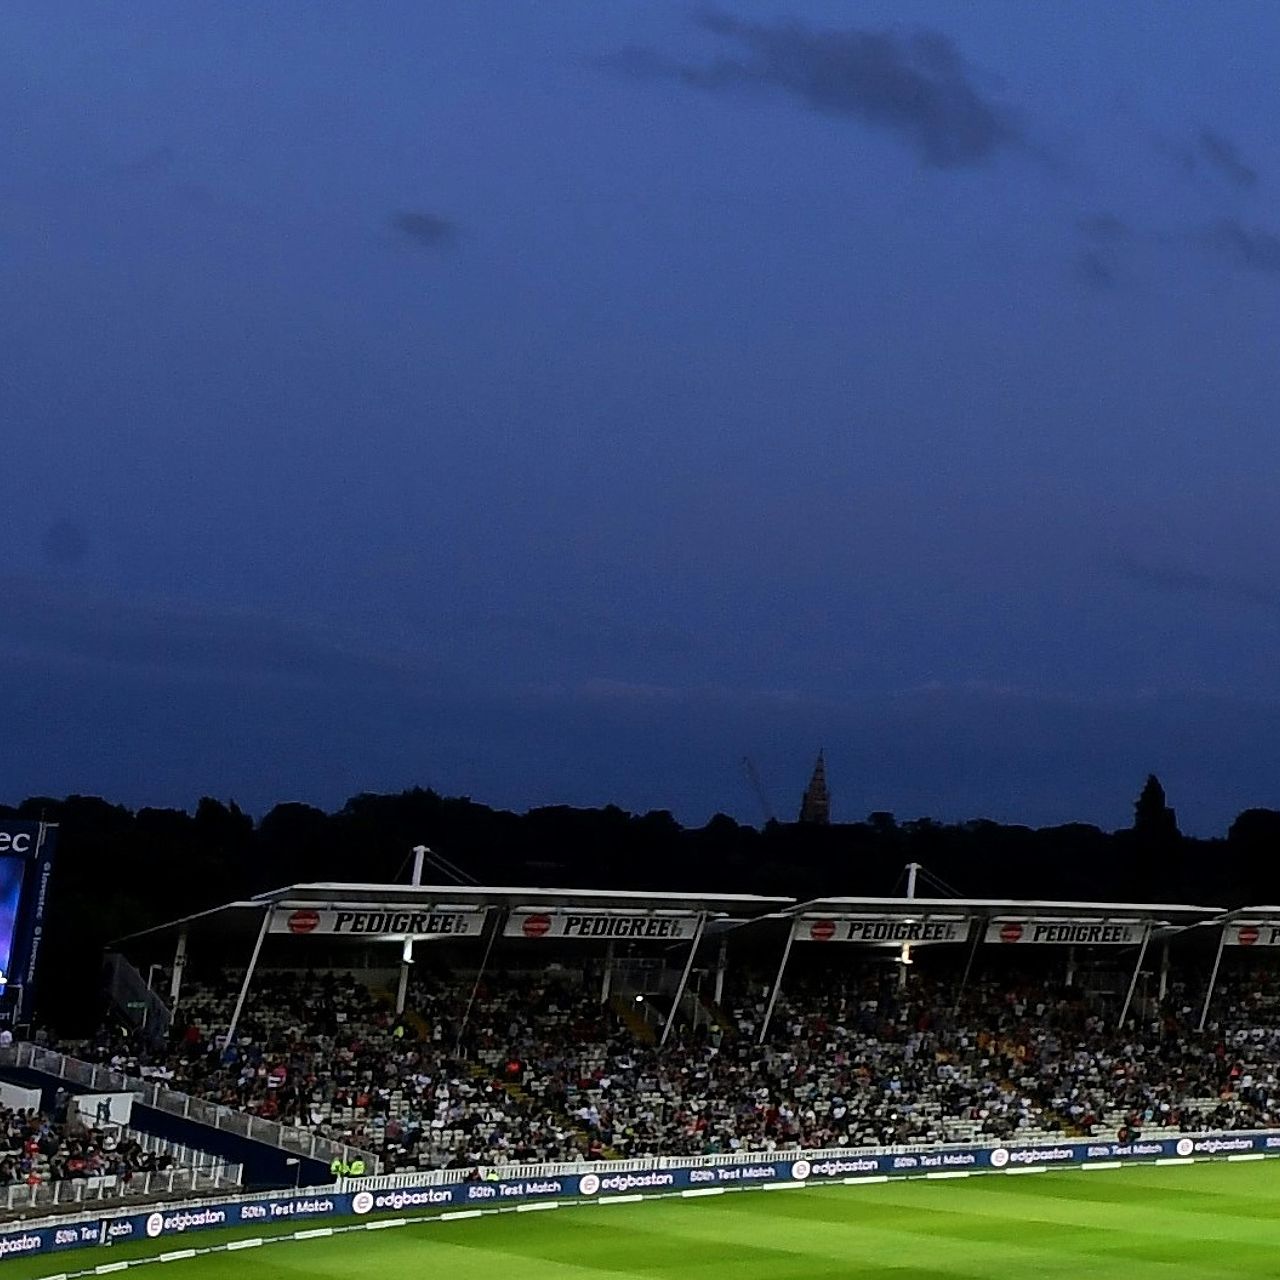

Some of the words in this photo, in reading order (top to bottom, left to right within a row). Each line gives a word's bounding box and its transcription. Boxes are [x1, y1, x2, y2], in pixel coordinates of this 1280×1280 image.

[333, 911, 456, 934] PEDIGREE
[562, 915, 672, 937] PEDIGREE
[846, 921, 946, 942] PEDIGREE
[1033, 923, 1124, 942] PEDIGREE
[1010, 1147, 1074, 1164] edgbaston
[690, 1169, 715, 1183] 50th
[717, 1167, 741, 1180] Test
[742, 1165, 776, 1180] Match
[811, 1158, 878, 1176] edgbaston
[468, 1186, 496, 1201] 50th
[499, 1184, 524, 1198] Test
[526, 1180, 562, 1195] Match
[601, 1172, 673, 1191] edgbaston
[241, 1206, 266, 1220] 50th
[270, 1202, 294, 1217] Test
[296, 1198, 334, 1213] Match
[375, 1188, 453, 1209] edgbaston
[164, 1209, 226, 1231] edgbaston
[80, 1228, 99, 1242] Tes
